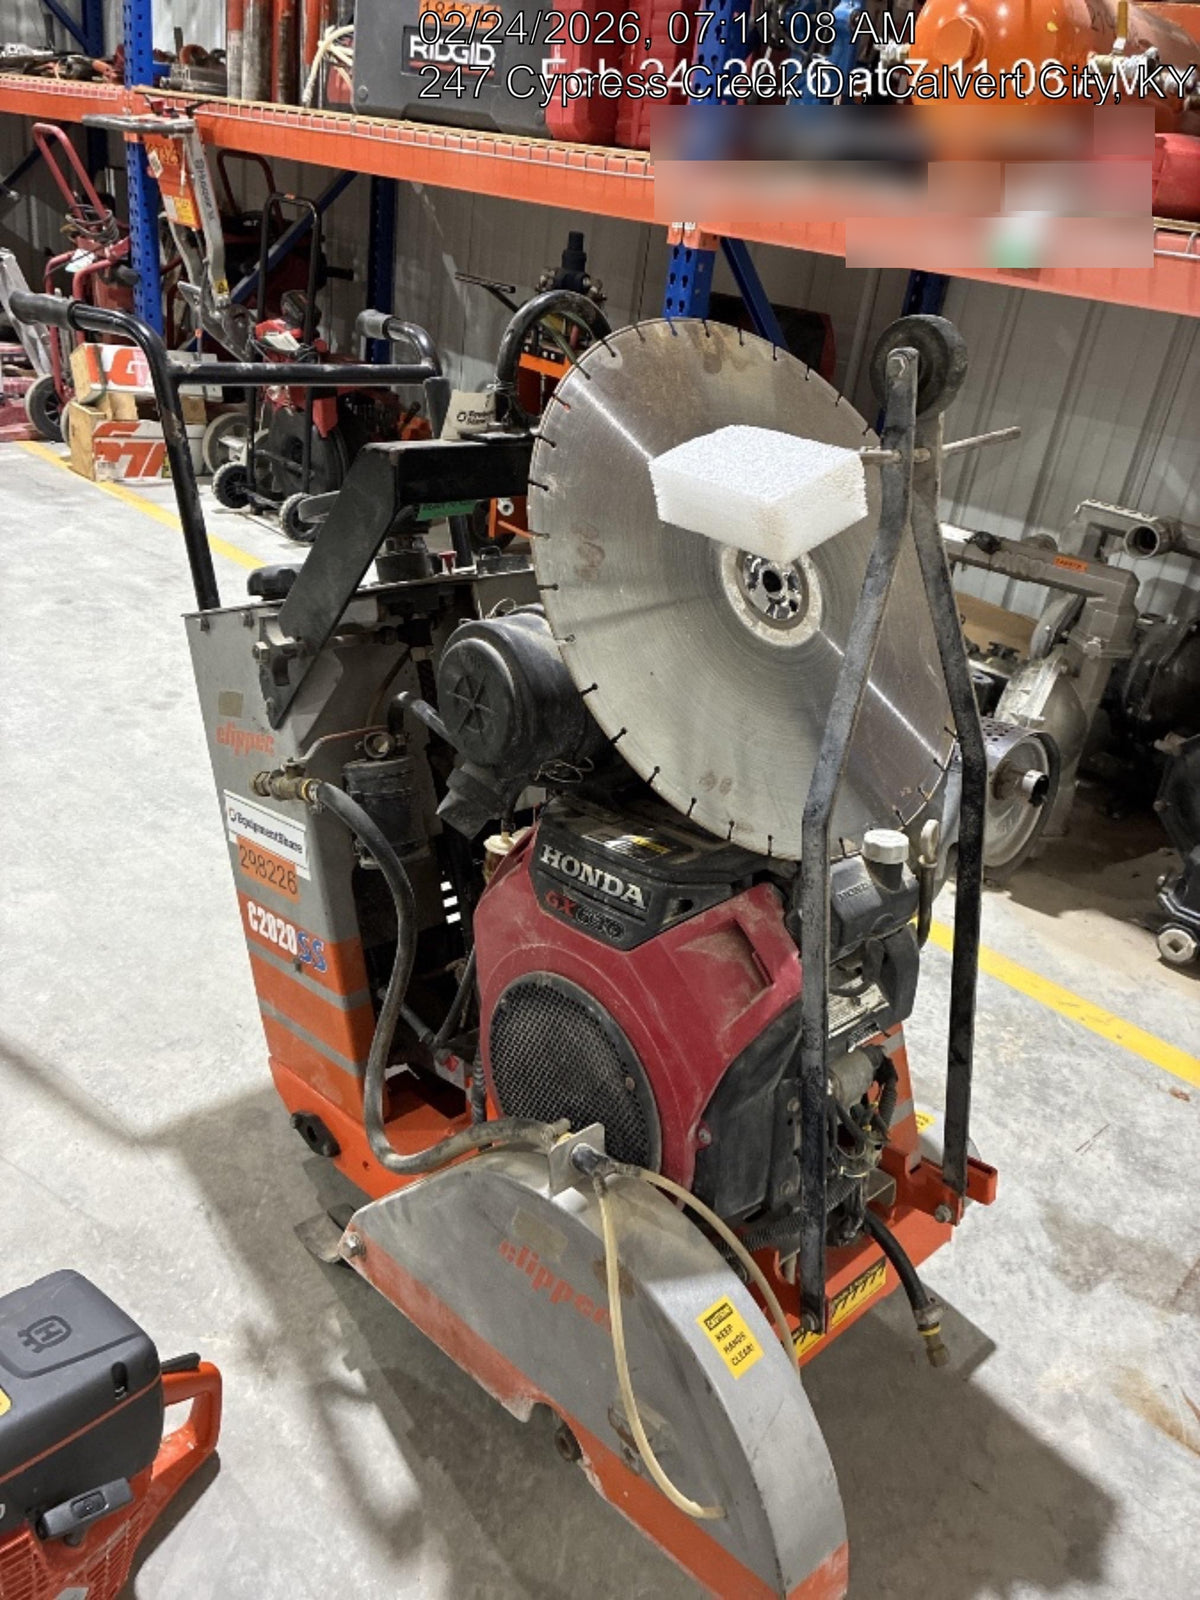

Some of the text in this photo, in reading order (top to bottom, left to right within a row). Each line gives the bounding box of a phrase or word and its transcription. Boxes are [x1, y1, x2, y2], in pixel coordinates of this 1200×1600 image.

[409, 35, 496, 67] RIDGID
[239, 843, 299, 896] 298226
[539, 843, 648, 910] HONDA
[714, 1323, 733, 1343] KEEP
